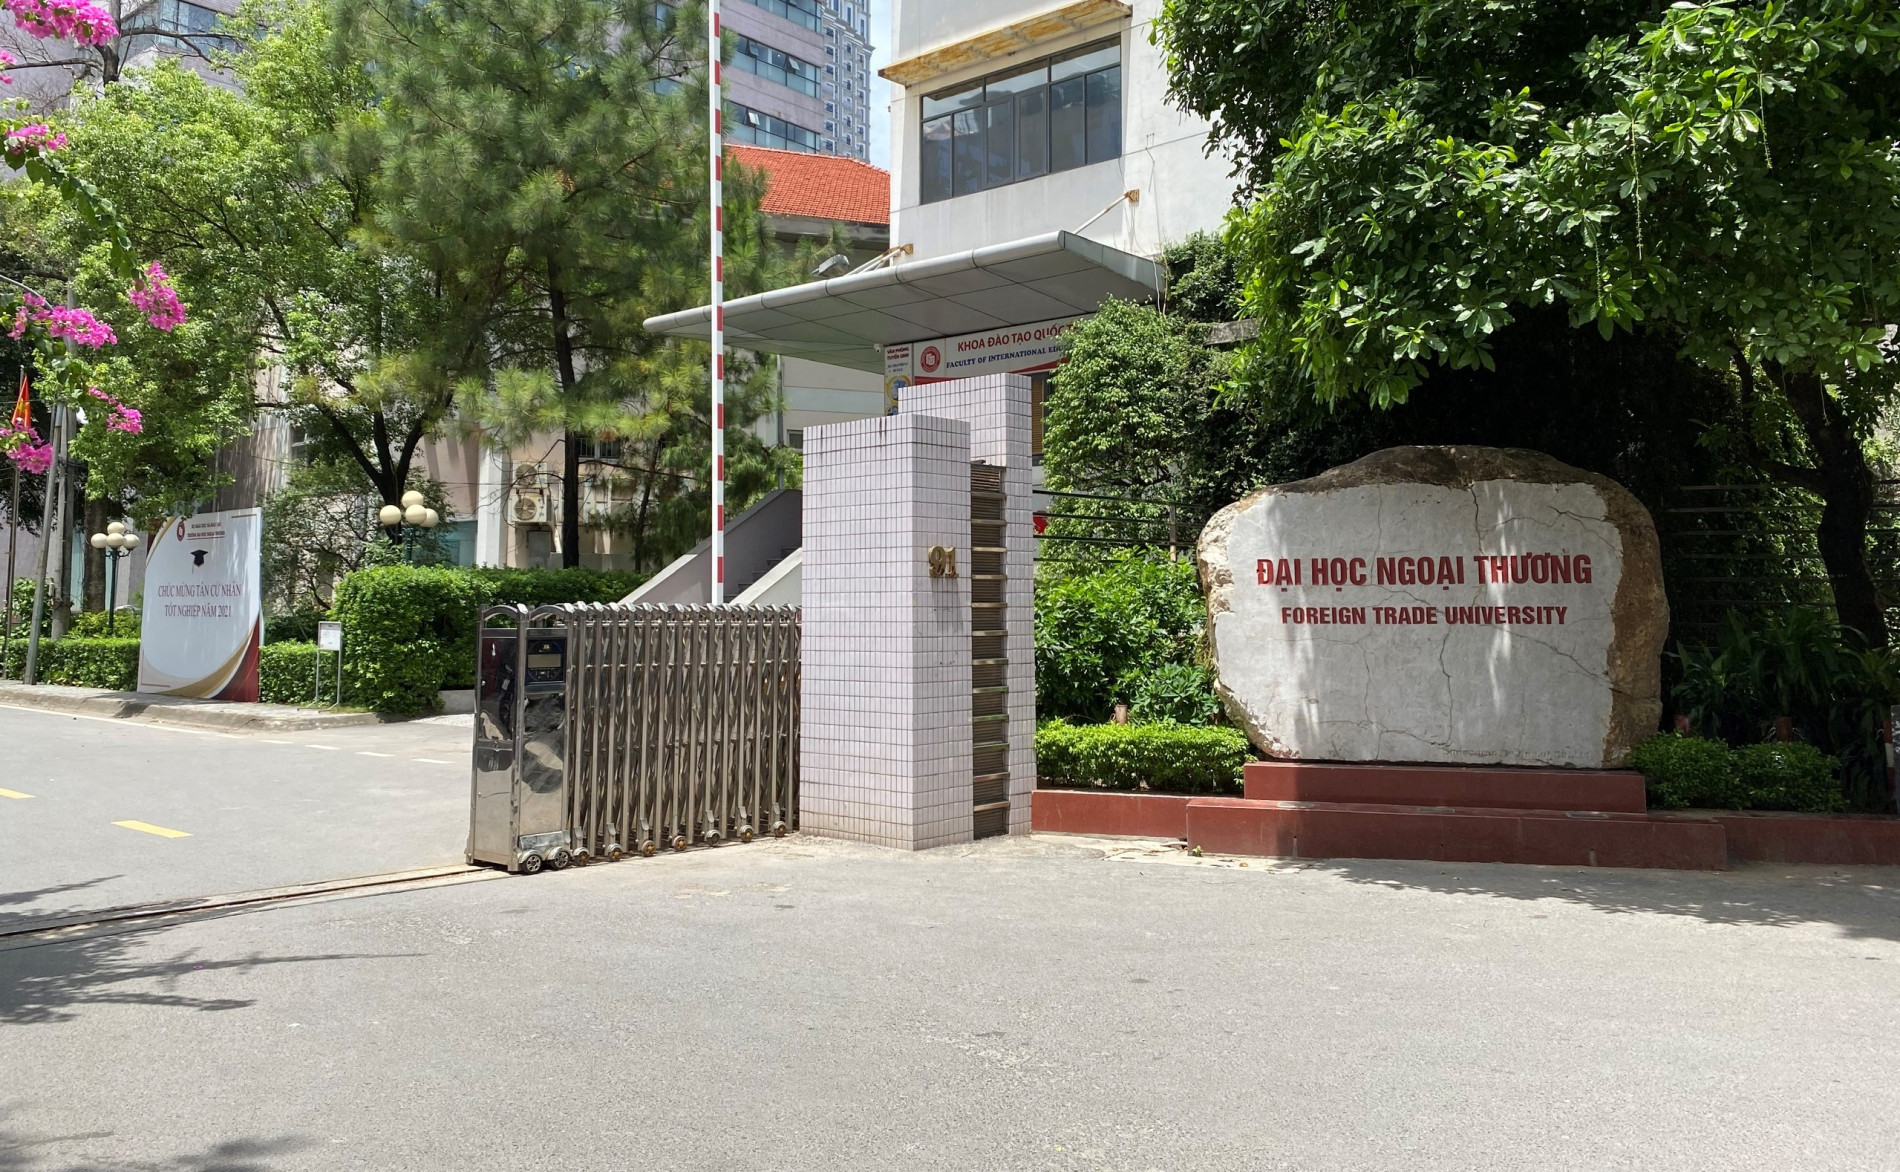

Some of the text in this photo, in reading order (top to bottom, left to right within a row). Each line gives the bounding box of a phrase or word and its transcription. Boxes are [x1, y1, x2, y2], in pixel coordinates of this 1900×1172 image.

[957, 339, 985, 352] KHOA
[988, 334, 1009, 347] ĐÀO
[1012, 331, 1031, 346] TẠO
[946, 358, 976, 368] FACULTY
[978, 356, 987, 364] OF
[988, 347, 1046, 362] INTERNATIONAL
[928, 546, 959, 578] 91
[1256, 552, 1592, 592] ĐẠI HỌC NGOẠI THƯƠNG
[158, 581, 175, 597] CHÚC
[176, 581, 195, 597] MỪNG
[196, 581, 209, 597] TÂN
[221, 581, 241, 597] NHÂN
[201, 602, 217, 617] NĂM
[217, 605, 231, 618] 2021
[1281, 606, 1568, 625] FOREIGN TRADE UNIVERSITY
